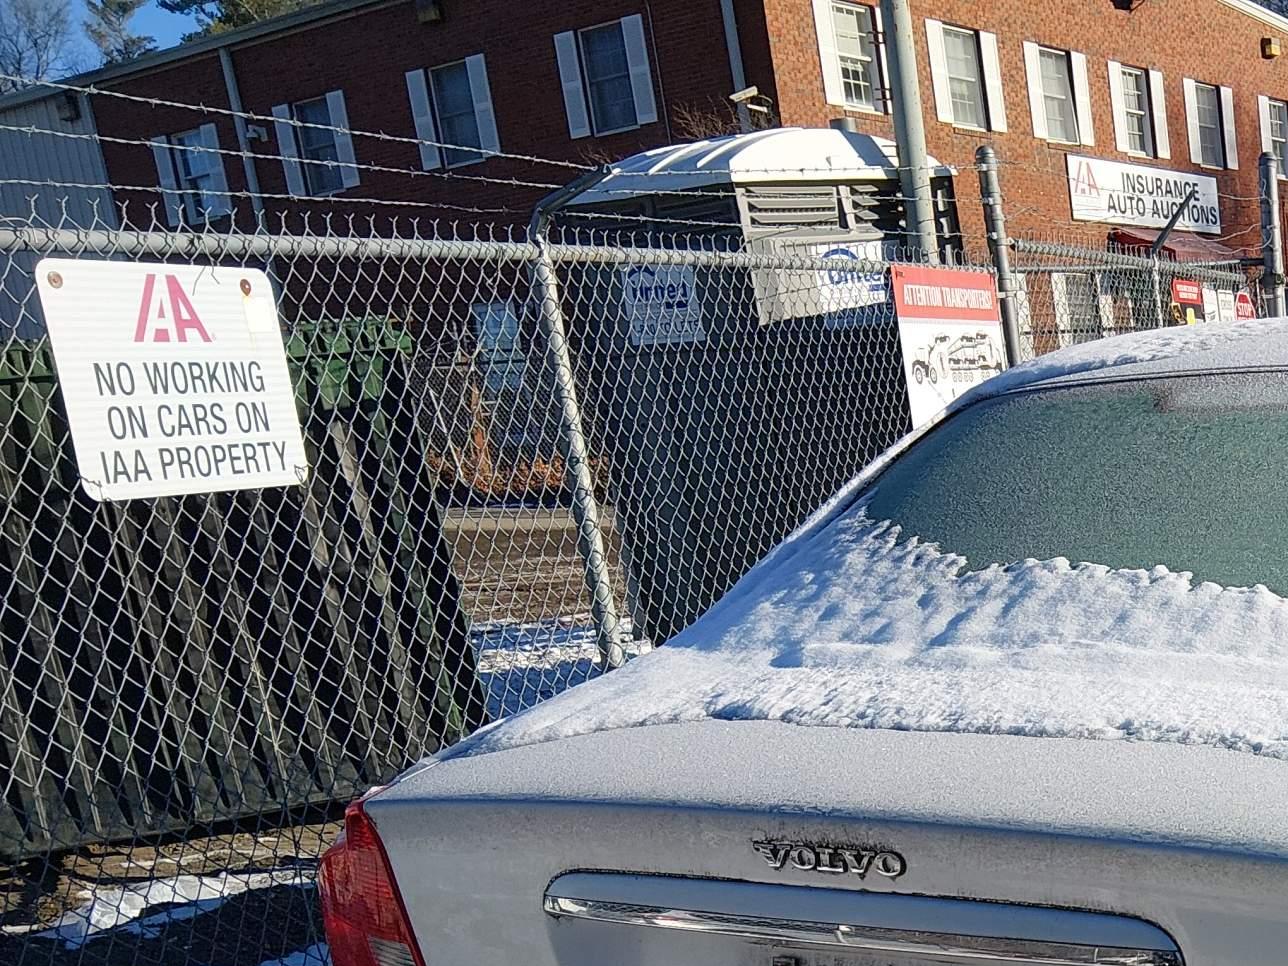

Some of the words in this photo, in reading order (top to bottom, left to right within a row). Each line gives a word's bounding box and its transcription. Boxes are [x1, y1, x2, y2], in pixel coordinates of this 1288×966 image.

[1121, 172, 1200, 201] INSURANCE
[1108, 194, 1146, 217] AUTO
[1152, 199, 1218, 225] AUCTIONS
[134, 273, 212, 343] IAA
[904, 284, 943, 307] ATTENTION
[1237, 303, 1253, 317] STOP
[94, 361, 137, 396] NO
[143, 361, 266, 395] WORKING
[107, 405, 149, 440] ON
[157, 403, 227, 437] CARS
[235, 401, 270, 433] ON
[101, 450, 152, 485] IAA
[158, 441, 287, 480] PROPERTY
[753, 840, 907, 877] VOLVO
